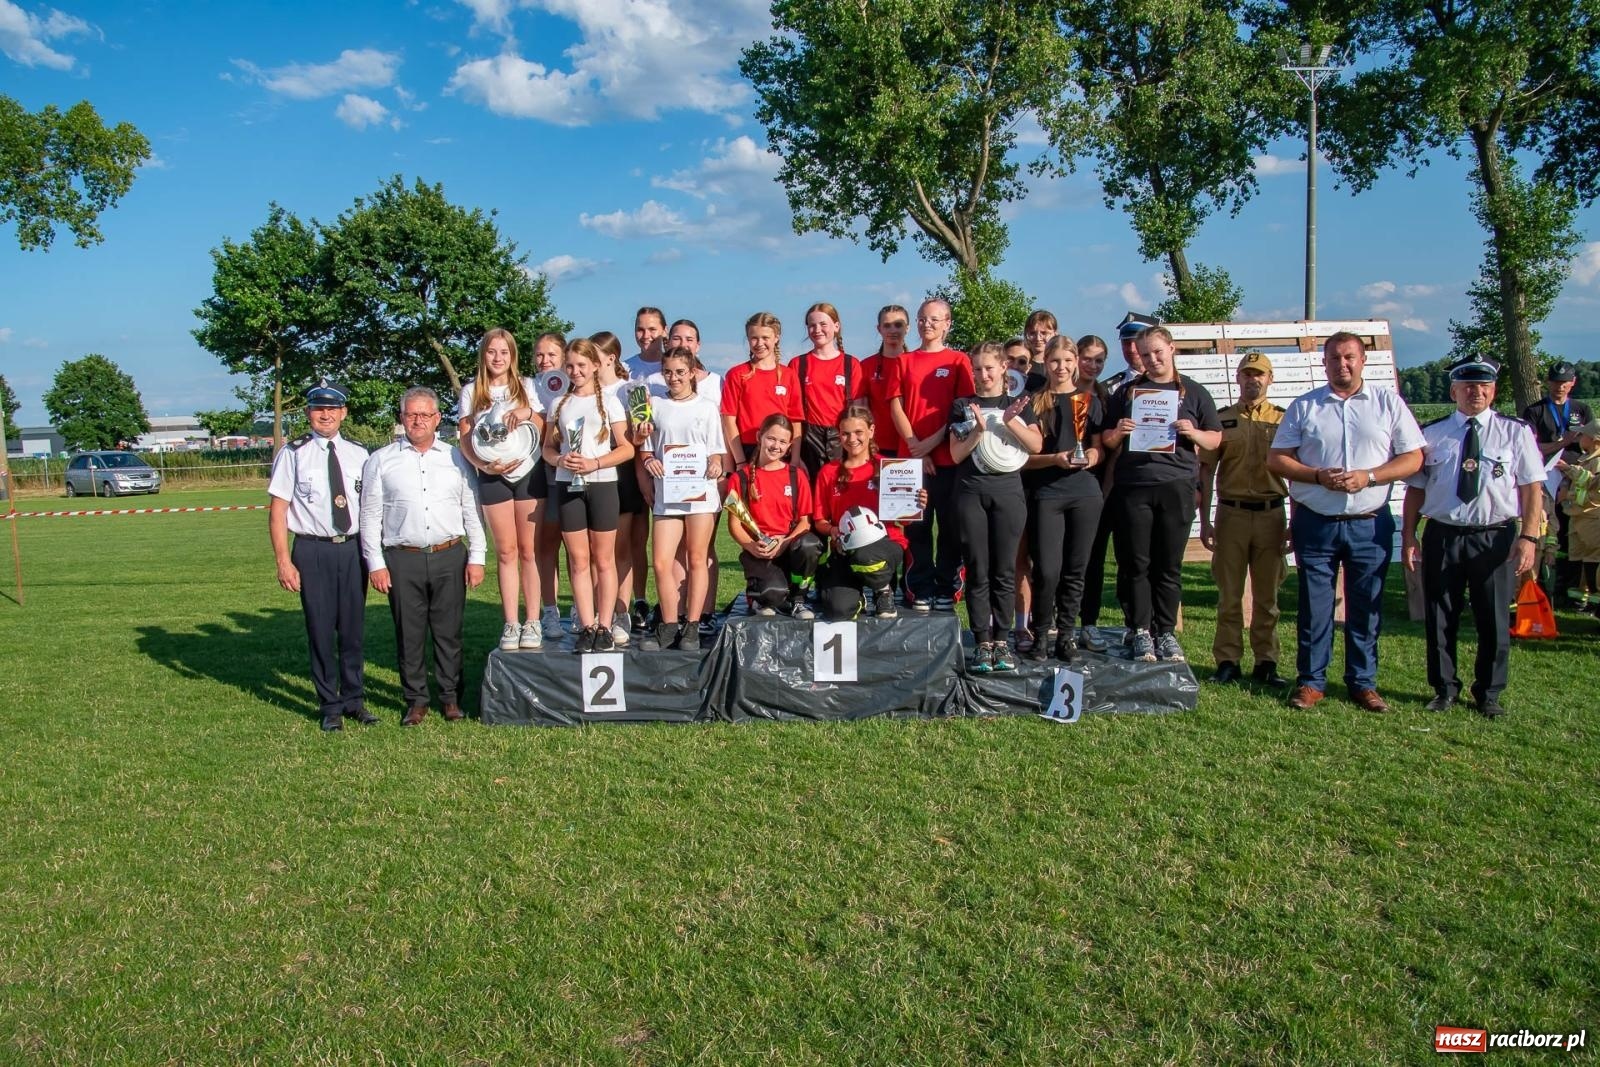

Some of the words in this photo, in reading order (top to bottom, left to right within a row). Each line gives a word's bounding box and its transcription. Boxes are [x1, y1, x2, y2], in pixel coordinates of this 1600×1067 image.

[823, 633, 842, 675] 1
[589, 665, 617, 705] 2
[1052, 683, 1075, 720] 3
